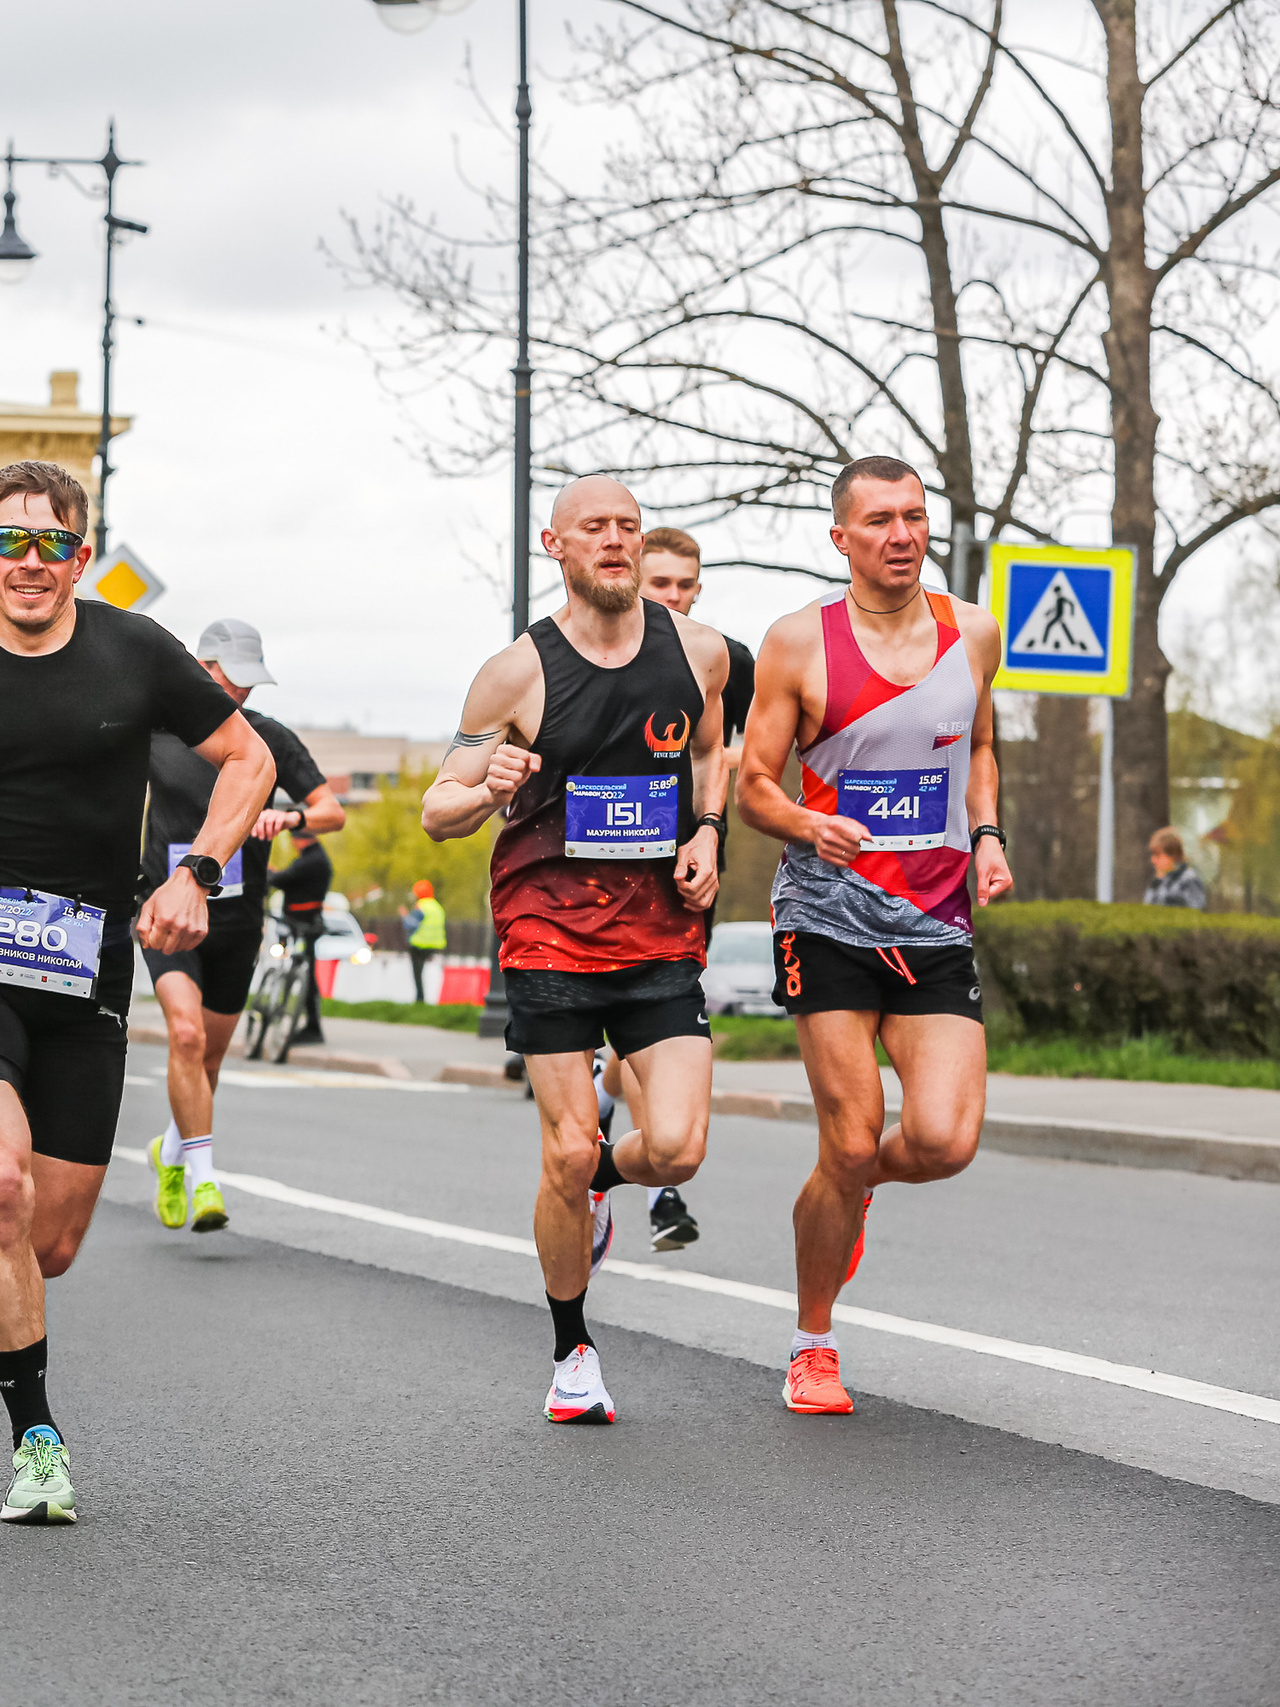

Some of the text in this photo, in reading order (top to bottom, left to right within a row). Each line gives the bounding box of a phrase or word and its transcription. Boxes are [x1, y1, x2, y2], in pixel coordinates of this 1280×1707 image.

[648, 780, 672, 790] 15.05
[918, 775, 943, 785] 15.05
[606, 802, 642, 826] 151
[867, 796, 920, 819] 441
[586, 829, 621, 837] МАУРИН
[62, 906, 92, 922] 15.05
